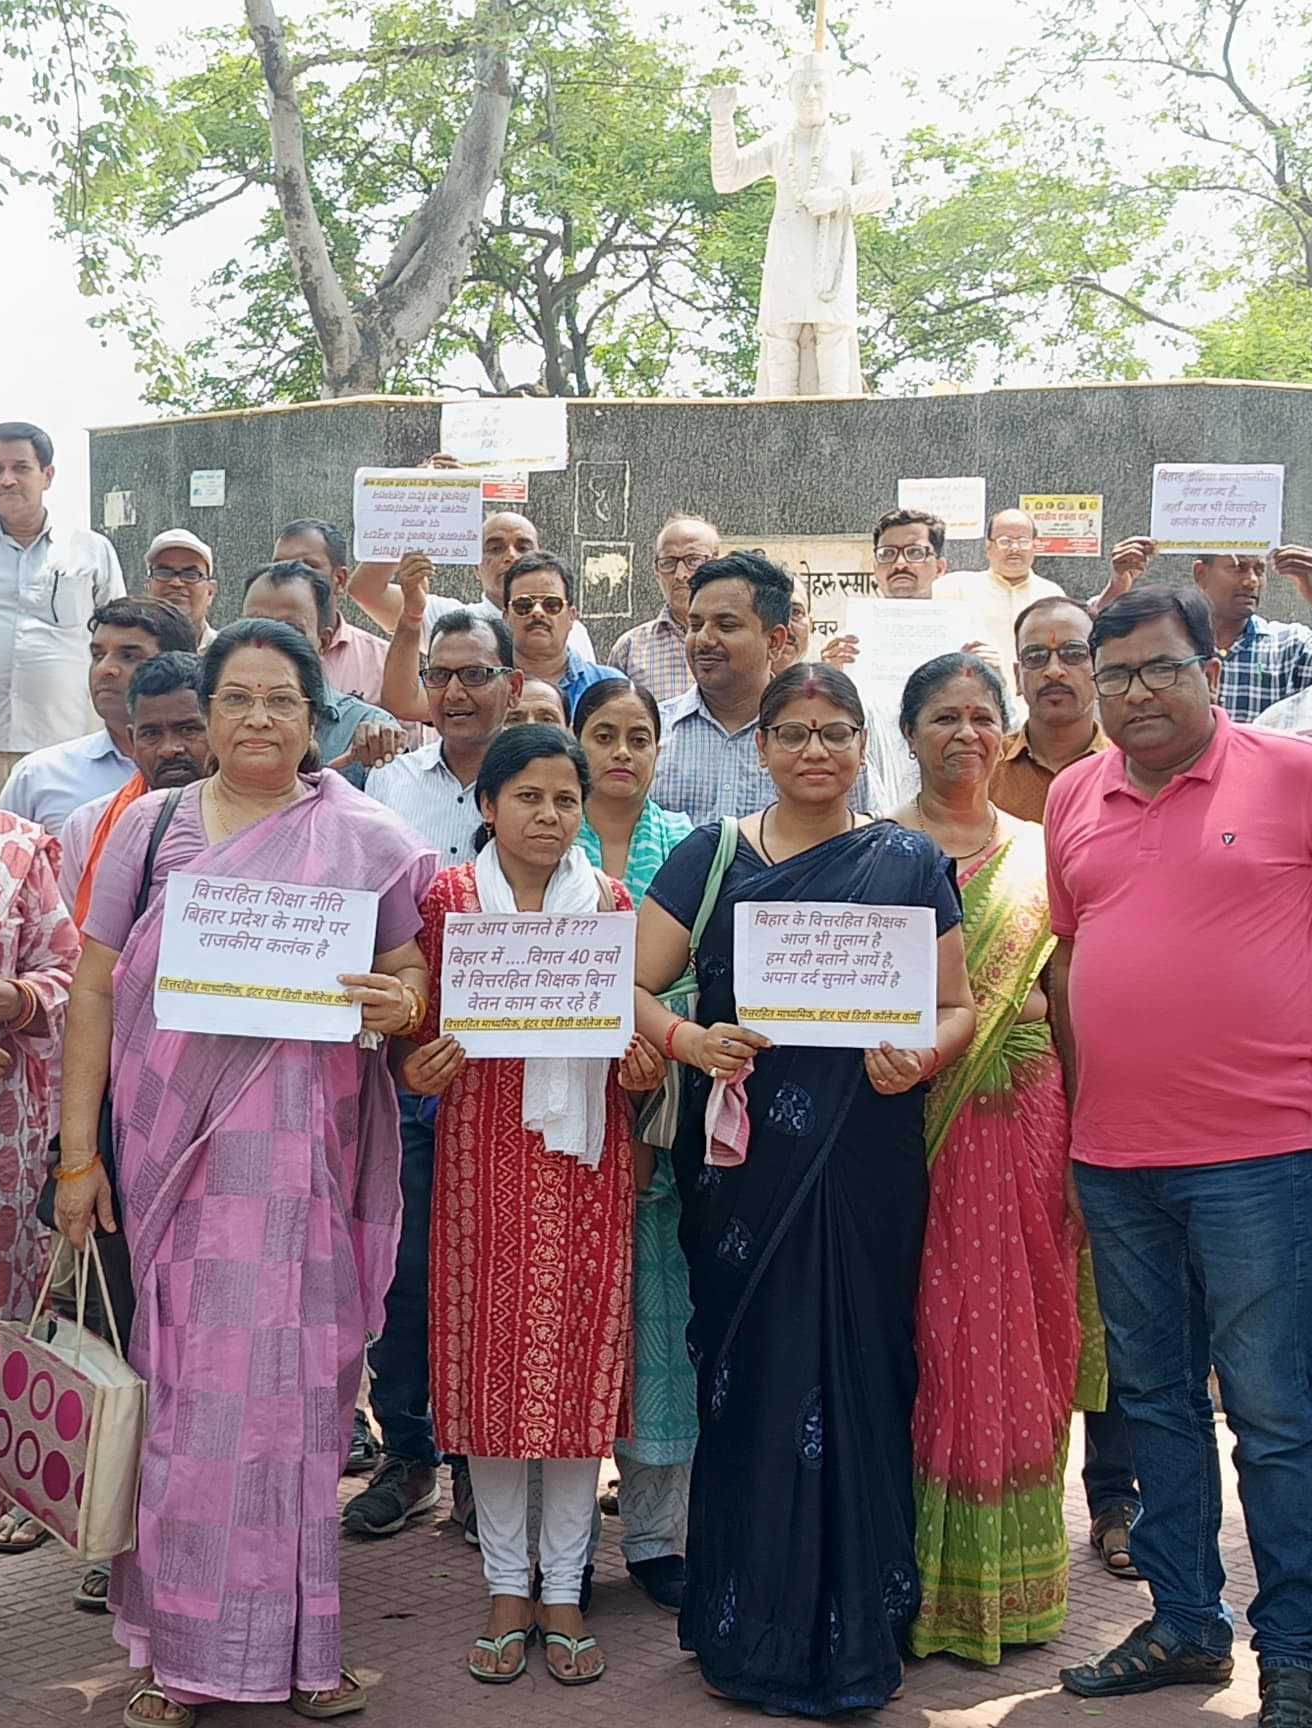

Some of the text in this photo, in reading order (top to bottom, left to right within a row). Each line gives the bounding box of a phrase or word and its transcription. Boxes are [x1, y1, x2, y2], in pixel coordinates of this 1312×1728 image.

[837, 572, 880, 598] स्मार
[191, 879, 346, 914] वित्तरहित शिक्षा नीति
[181, 902, 351, 937] बिहार प्रदेश के माथे पर
[446, 917, 598, 937] क्या आप जानते हैं ???
[754, 910, 909, 929] बिहार के वित्तरहित शिक्षक
[199, 928, 331, 960] राजकीय कलंक है
[781, 933, 810, 946] आज
[814, 930, 831, 946] भी
[871, 931, 883, 949] है
[447, 946, 487, 968] बिहार
[491, 946, 506, 965] में
[567, 949, 590, 965] 40
[765, 952, 785, 967] हम
[789, 950, 813, 967] यही
[450, 969, 617, 990] से वित्तरहित शिक्षक बिना
[761, 971, 797, 985] अपना
[800, 968, 820, 985] दर्द
[822, 970, 858, 989] सुनाने
[889, 971, 902, 988] है
[467, 990, 602, 1012] वेतन काम कर रहे हैं
